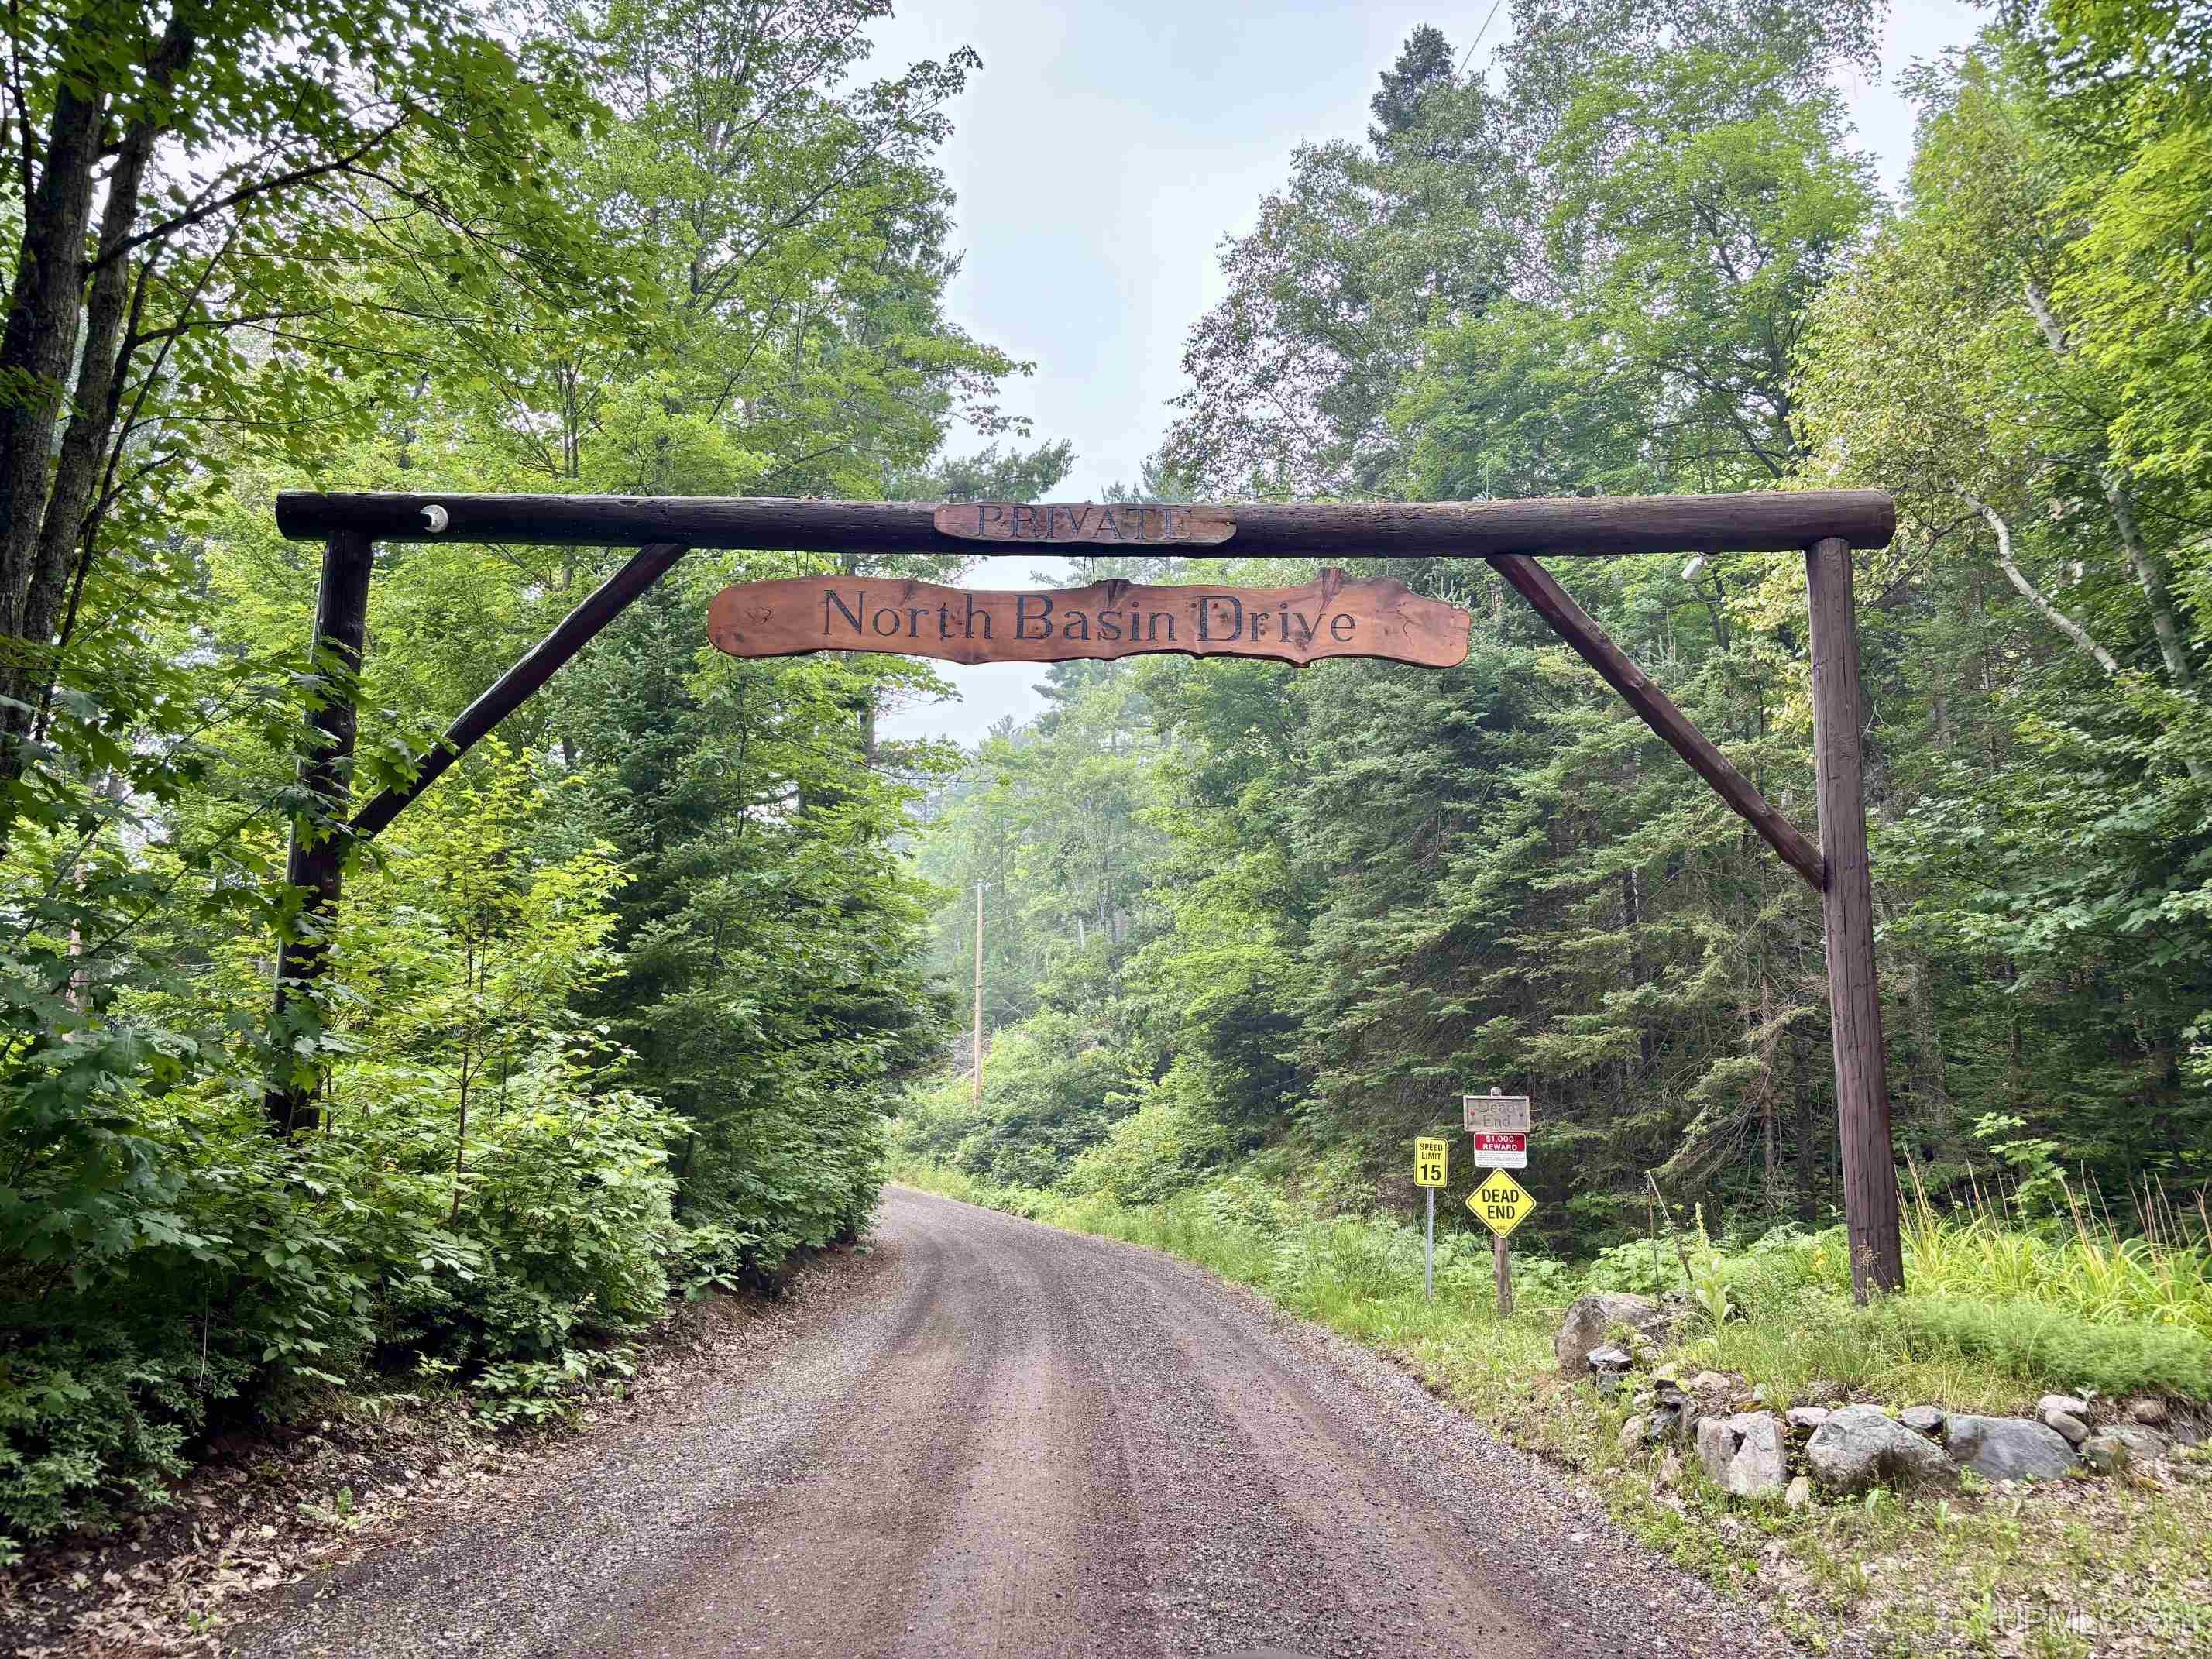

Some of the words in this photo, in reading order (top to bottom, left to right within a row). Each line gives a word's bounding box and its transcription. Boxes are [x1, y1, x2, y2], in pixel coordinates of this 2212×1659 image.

[977, 505, 1192, 540] PRIVATE
[822, 589, 993, 641] North
[1014, 593, 1179, 642] Basin
[1197, 595, 1356, 643] Drive
[1482, 1114, 1511, 1128] End
[1420, 1142, 1443, 1152] SPEED
[1421, 1152, 1441, 1160] LIMIT
[1420, 1164, 1441, 1181] 15
[1482, 1189, 1520, 1203] DEAD
[1487, 1205, 1516, 1219] END
